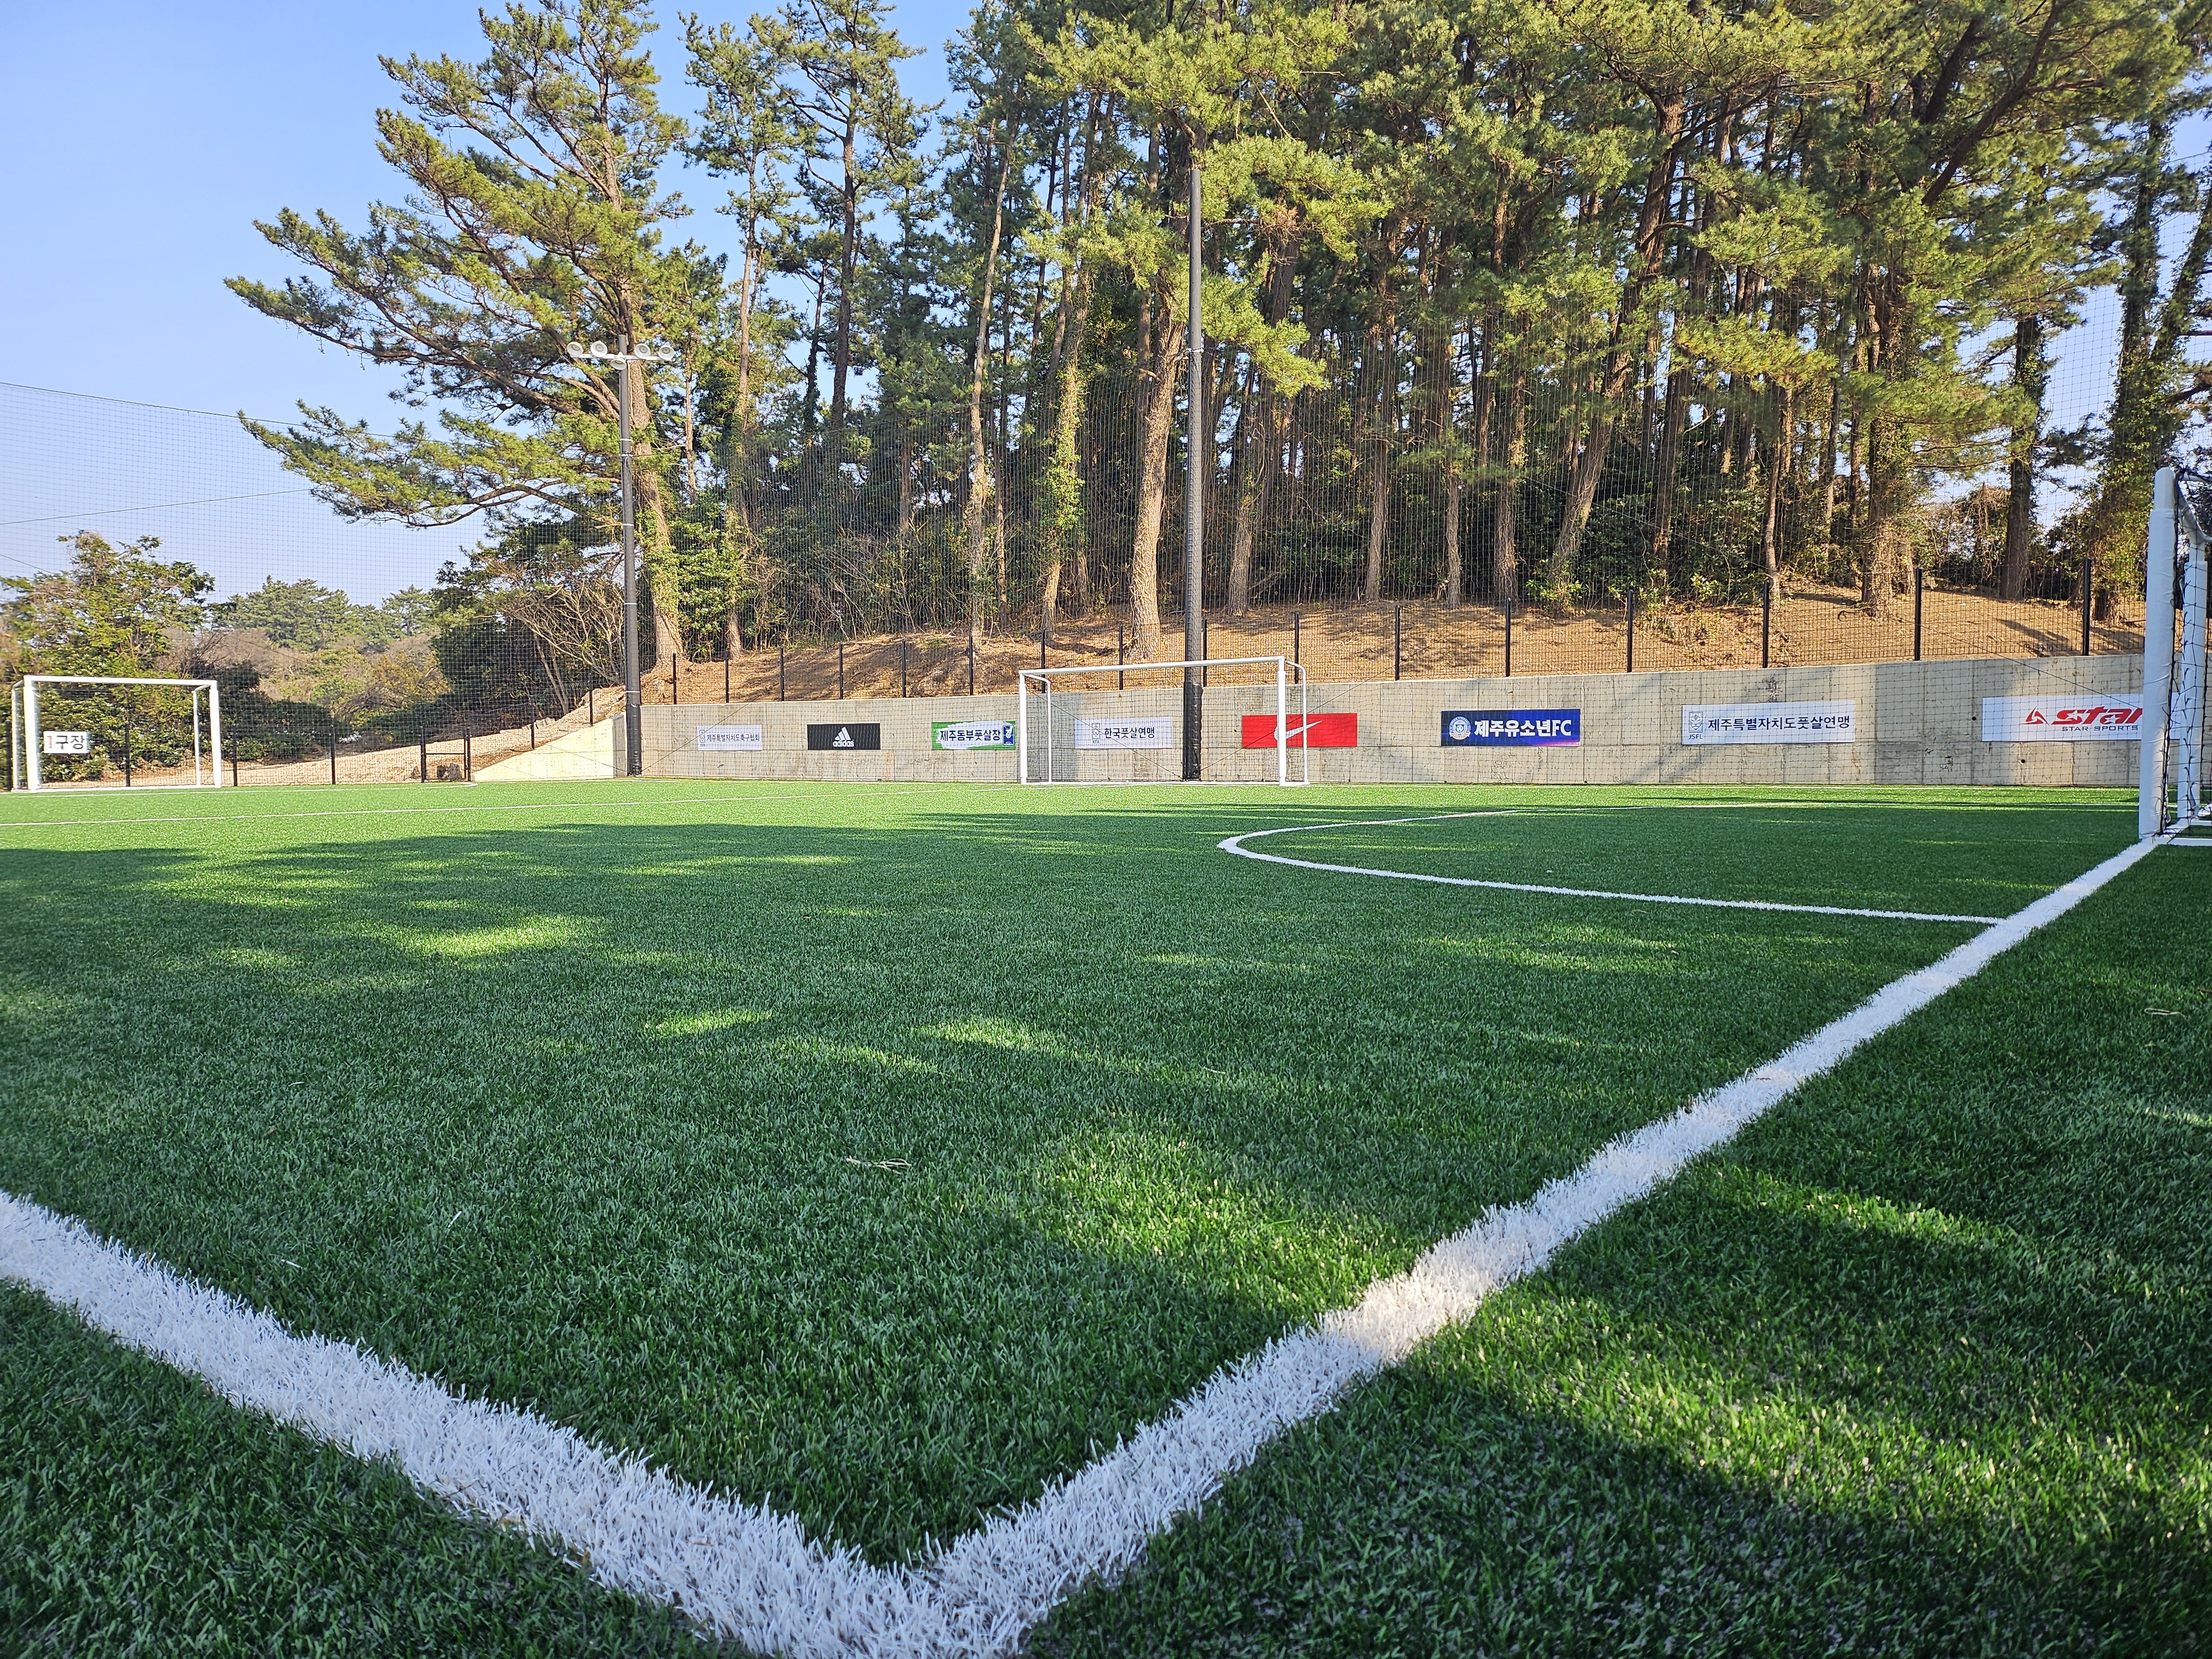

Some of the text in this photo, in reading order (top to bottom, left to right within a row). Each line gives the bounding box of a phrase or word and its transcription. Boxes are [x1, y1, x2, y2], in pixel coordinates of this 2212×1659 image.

[1474, 719, 1572, 737] 제주유소년FC
[1708, 715, 1850, 731] 제주특별자치도풋살연맹
[940, 729, 1001, 741] 제주동부풋살장
[1104, 727, 1155, 739] 한국풋살연맹
